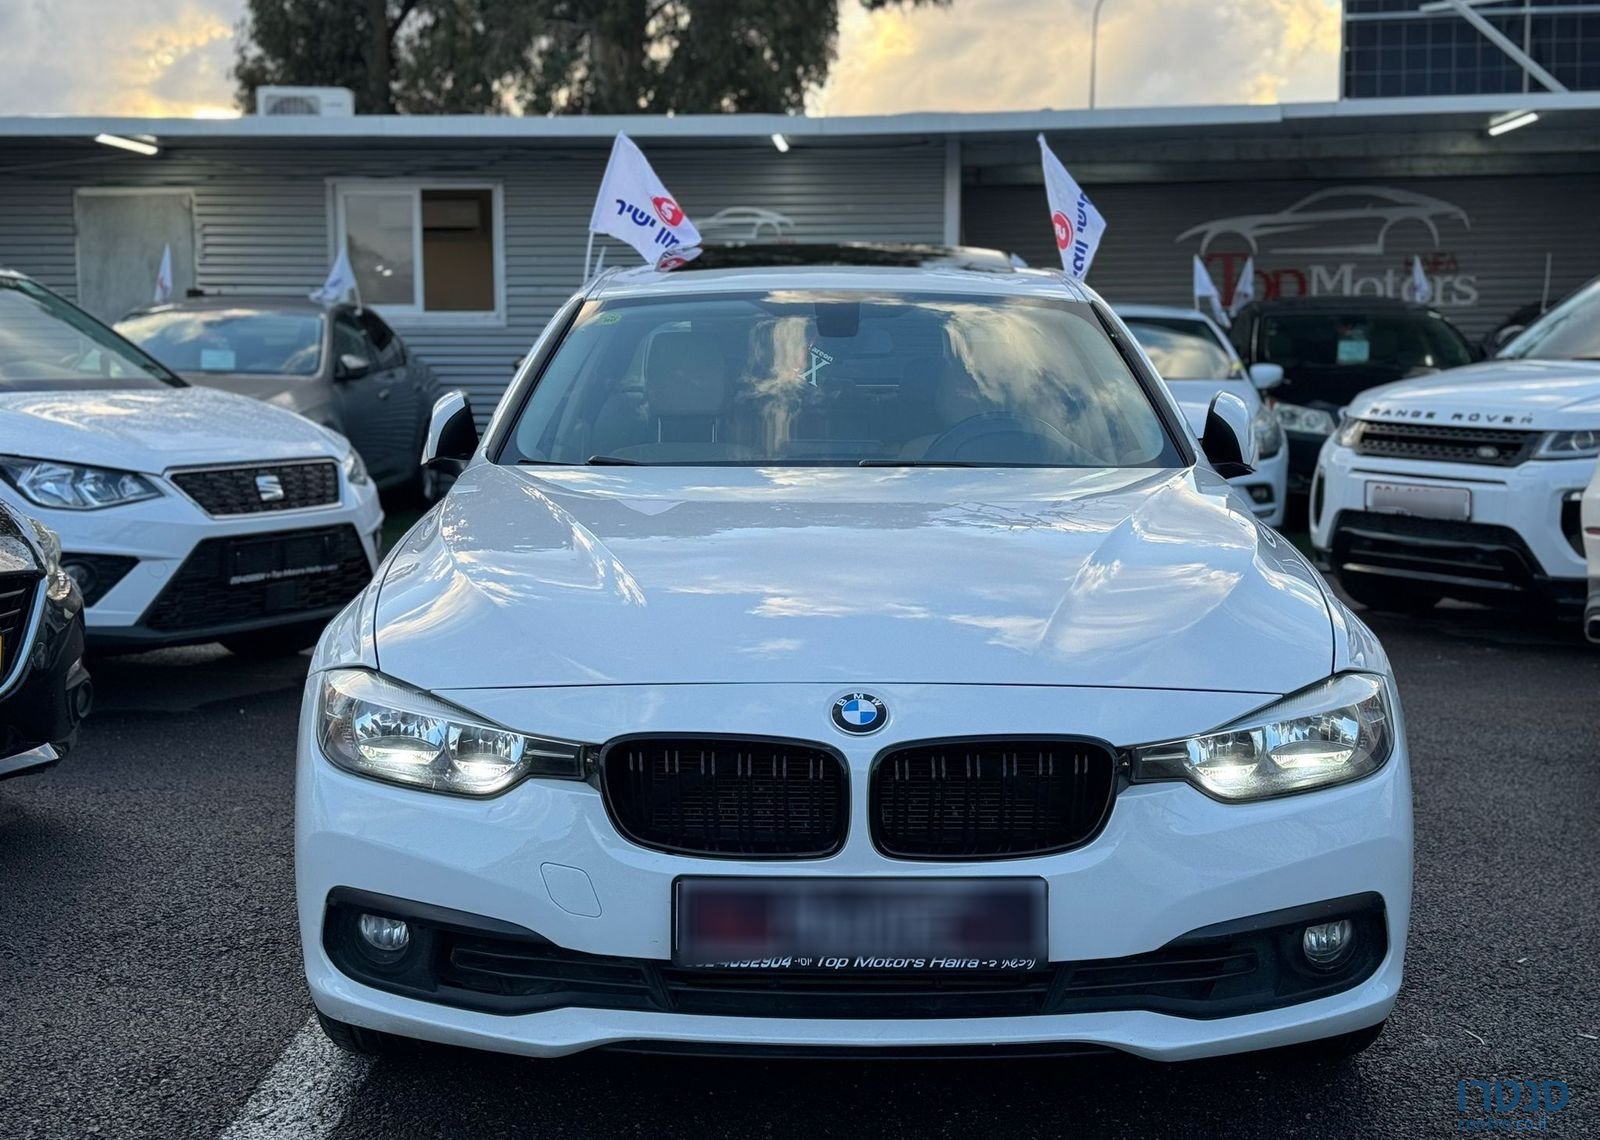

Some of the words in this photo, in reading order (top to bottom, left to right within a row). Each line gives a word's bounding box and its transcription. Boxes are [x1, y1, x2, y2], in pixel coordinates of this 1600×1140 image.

[615, 198, 657, 228] ישיר
[811, 346, 833, 362] areon
[1369, 408, 1437, 420] RANGE
[1451, 412, 1534, 424] ROVER
[836, 693, 883, 707] BMW
[853, 956, 926, 968] Motors
